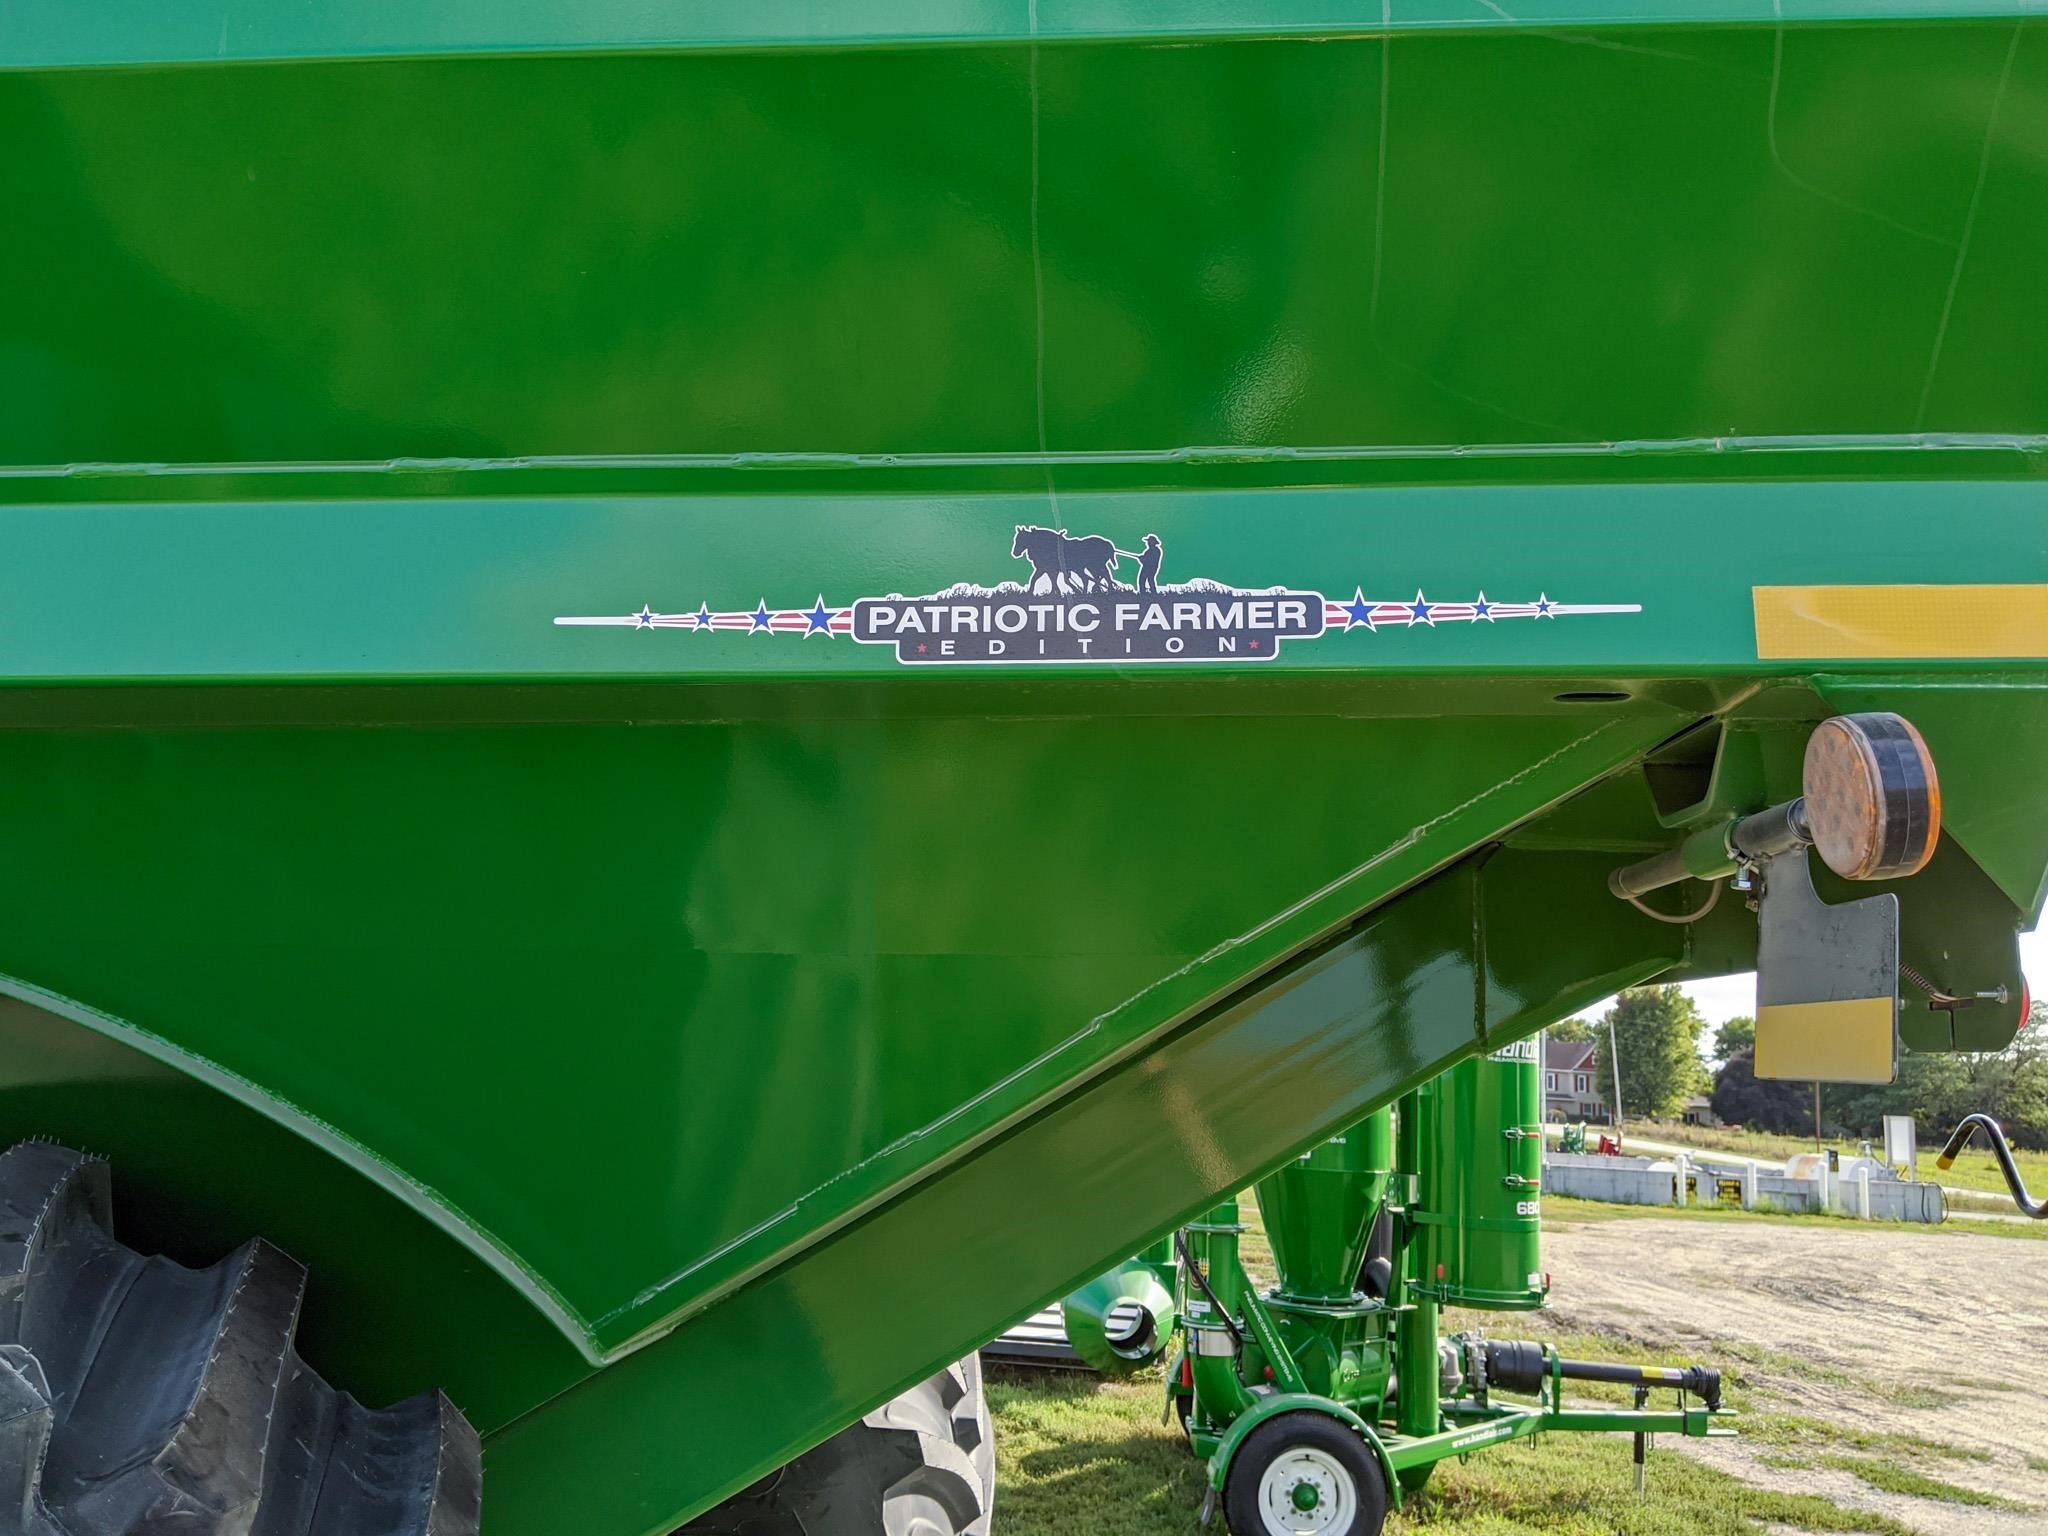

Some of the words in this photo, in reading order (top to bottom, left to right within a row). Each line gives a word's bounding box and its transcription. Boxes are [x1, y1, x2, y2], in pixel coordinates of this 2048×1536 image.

[869, 602, 1100, 633] PATRIOTIC
[1115, 601, 1307, 630] FARMER
[941, 637, 1236, 656] EDITION
